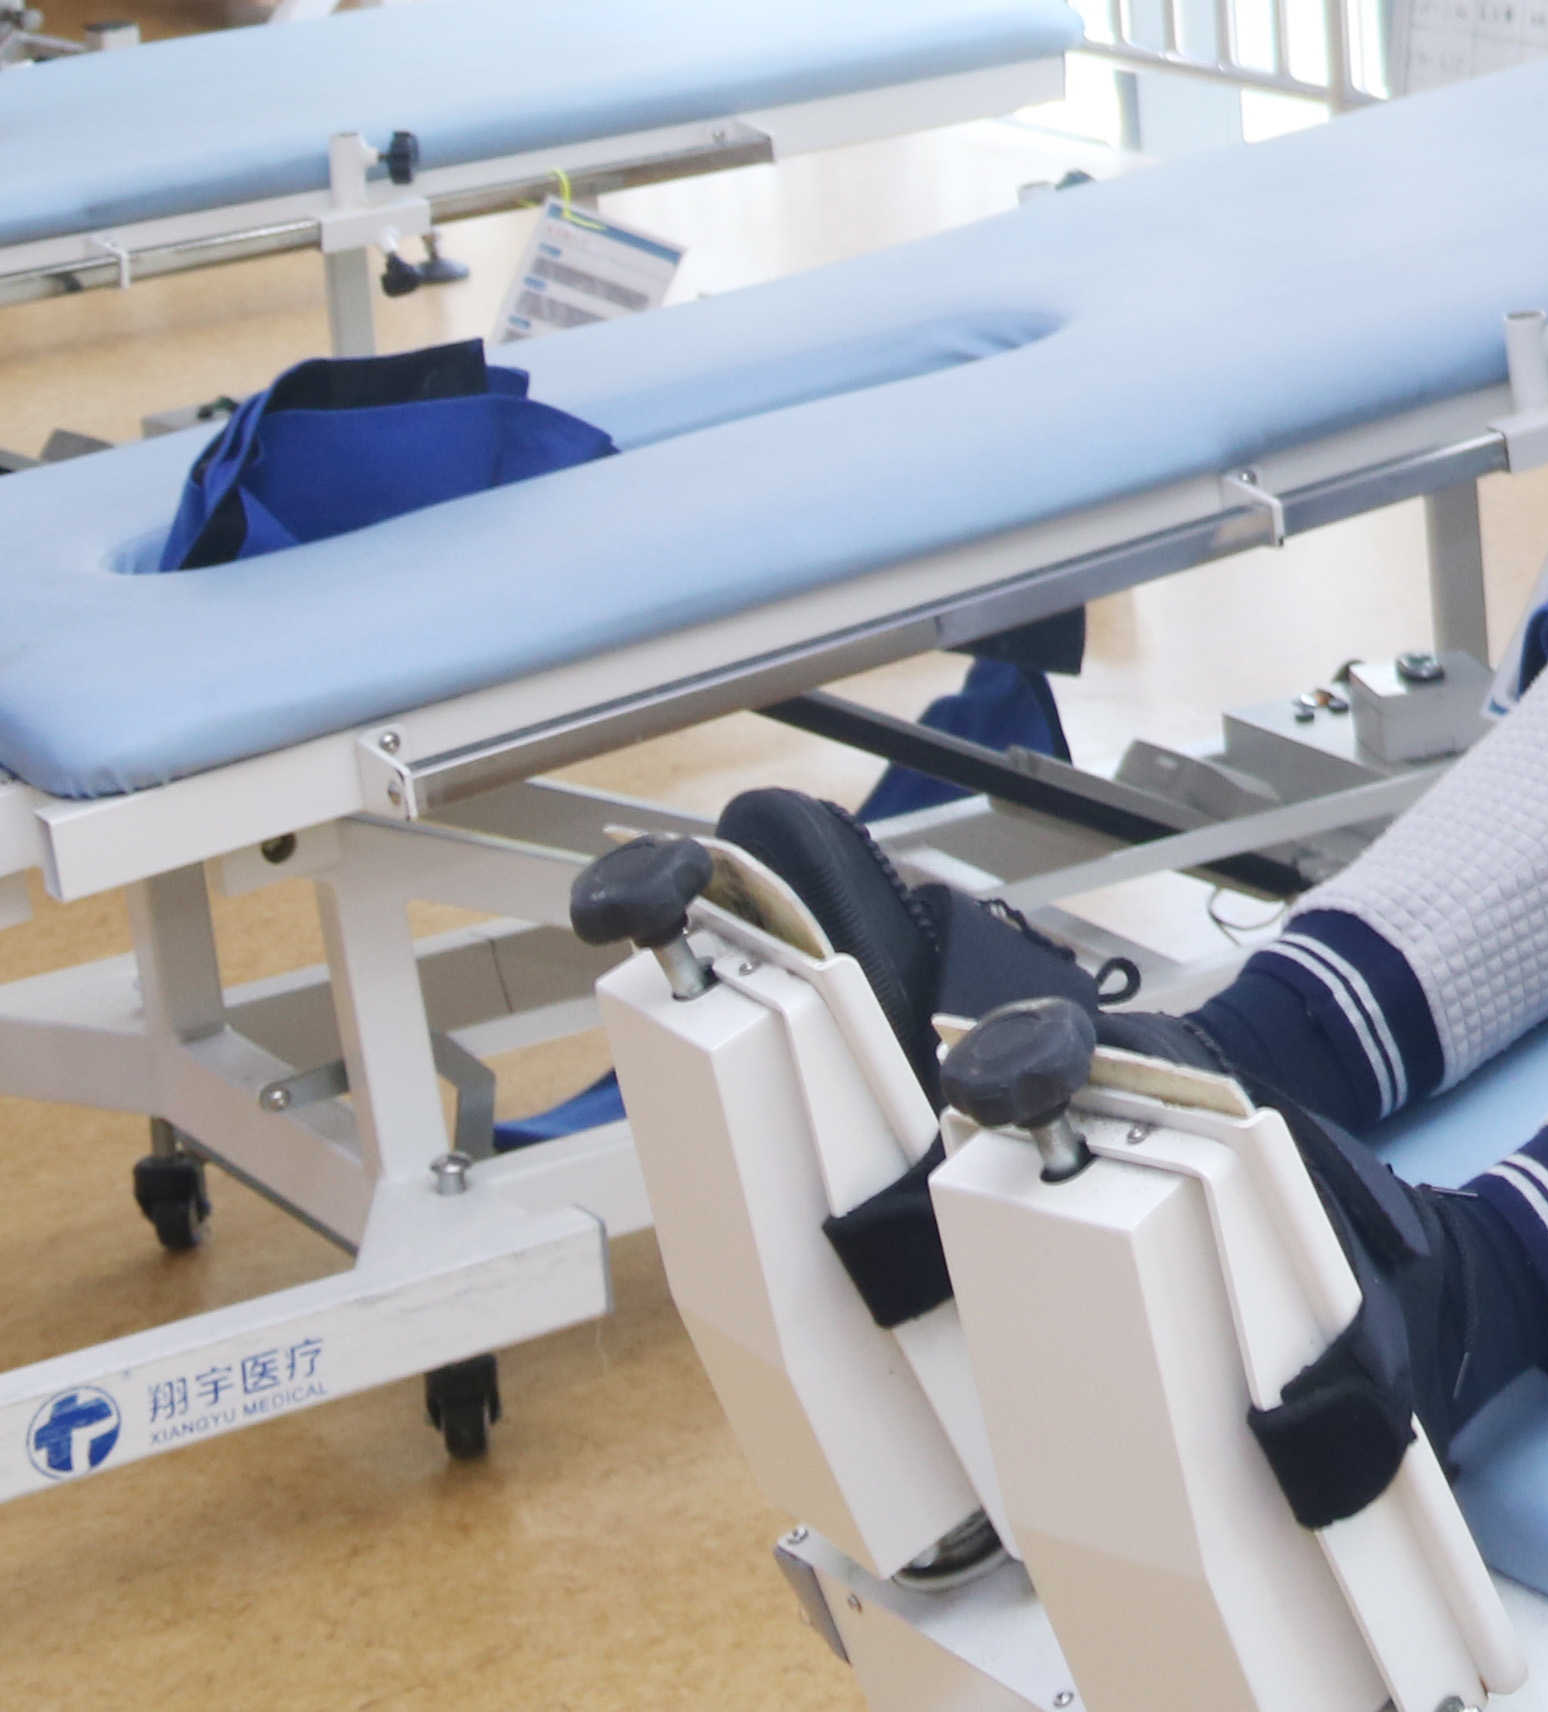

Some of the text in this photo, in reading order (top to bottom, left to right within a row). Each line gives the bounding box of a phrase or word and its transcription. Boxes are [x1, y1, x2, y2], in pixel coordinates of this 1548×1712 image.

[149, 1338, 323, 1422] 翔宇医疗
[151, 1381, 327, 1445] XIANGYU MEDICAL
